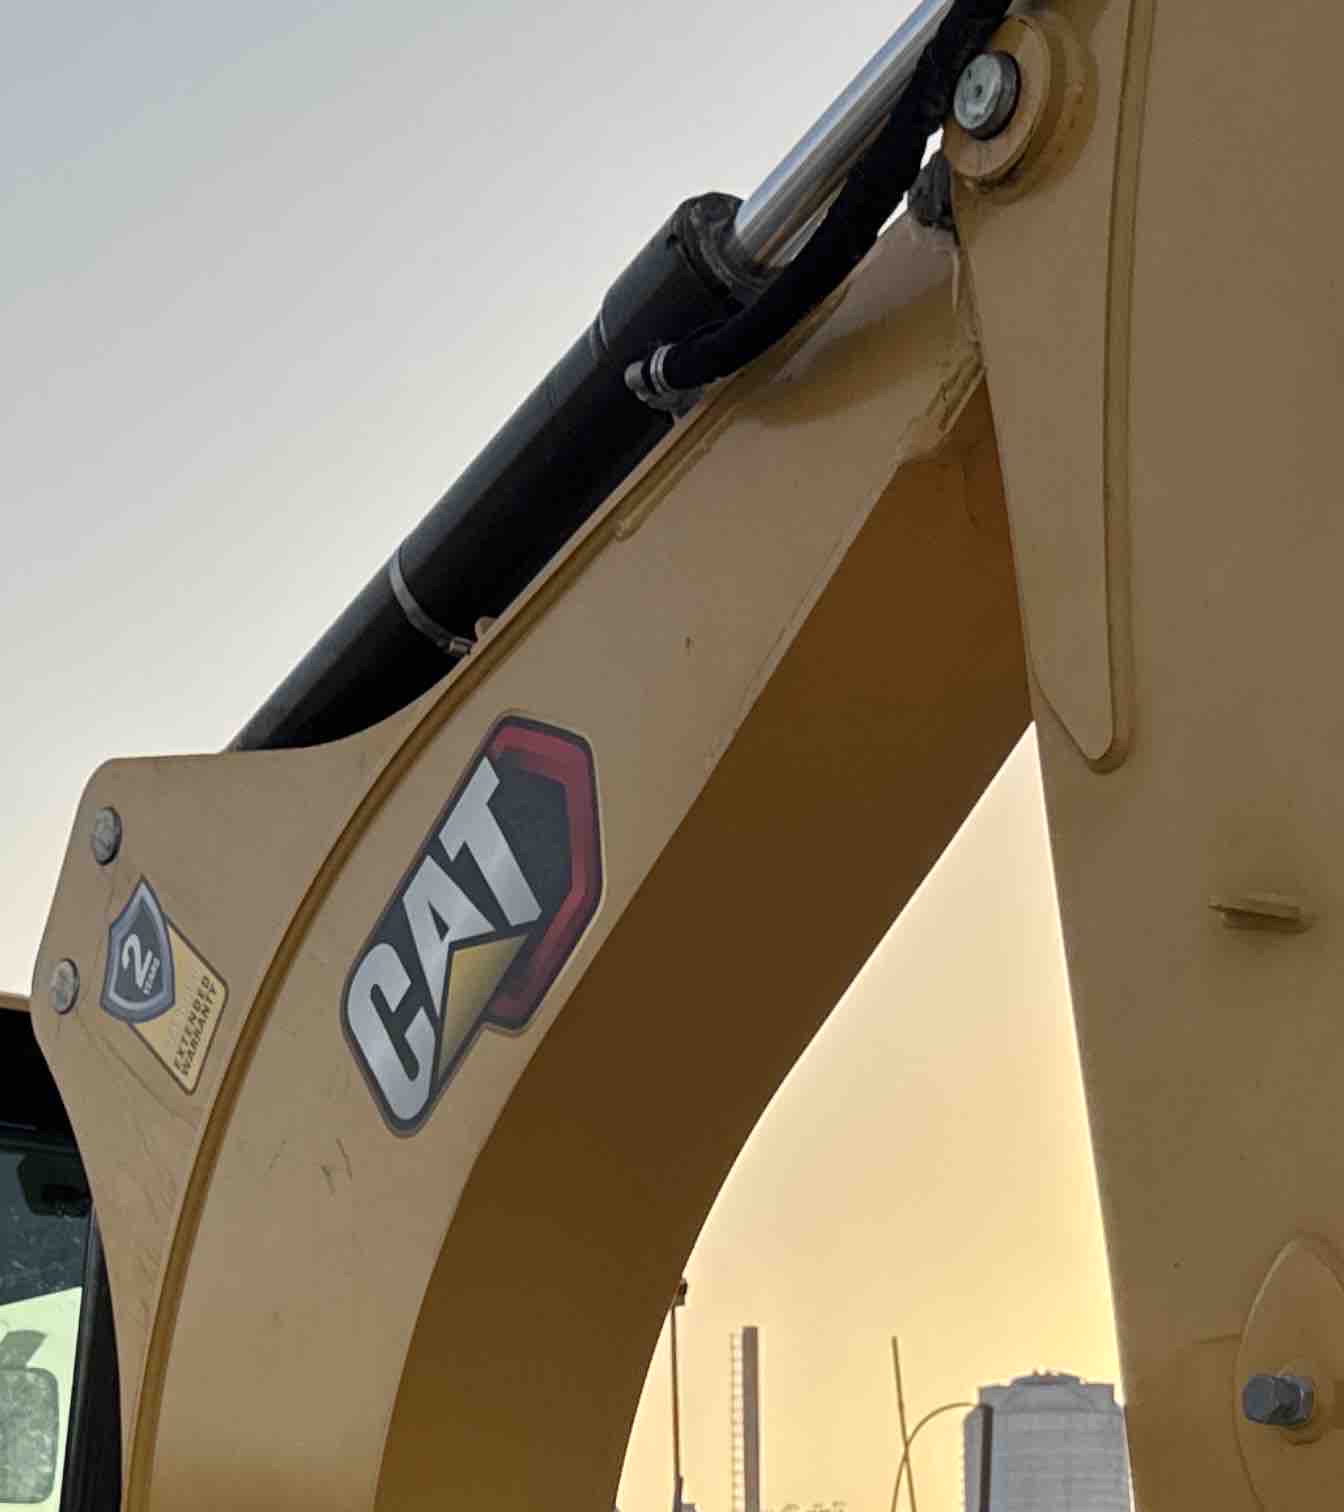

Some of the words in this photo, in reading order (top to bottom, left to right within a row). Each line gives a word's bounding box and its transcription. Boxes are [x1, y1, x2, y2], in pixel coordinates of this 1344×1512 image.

[121, 933, 153, 988] 2
[347, 756, 543, 1121] CAT
[173, 975, 211, 1070] EXTENDED
[181, 983, 217, 1075] WARRANTY
